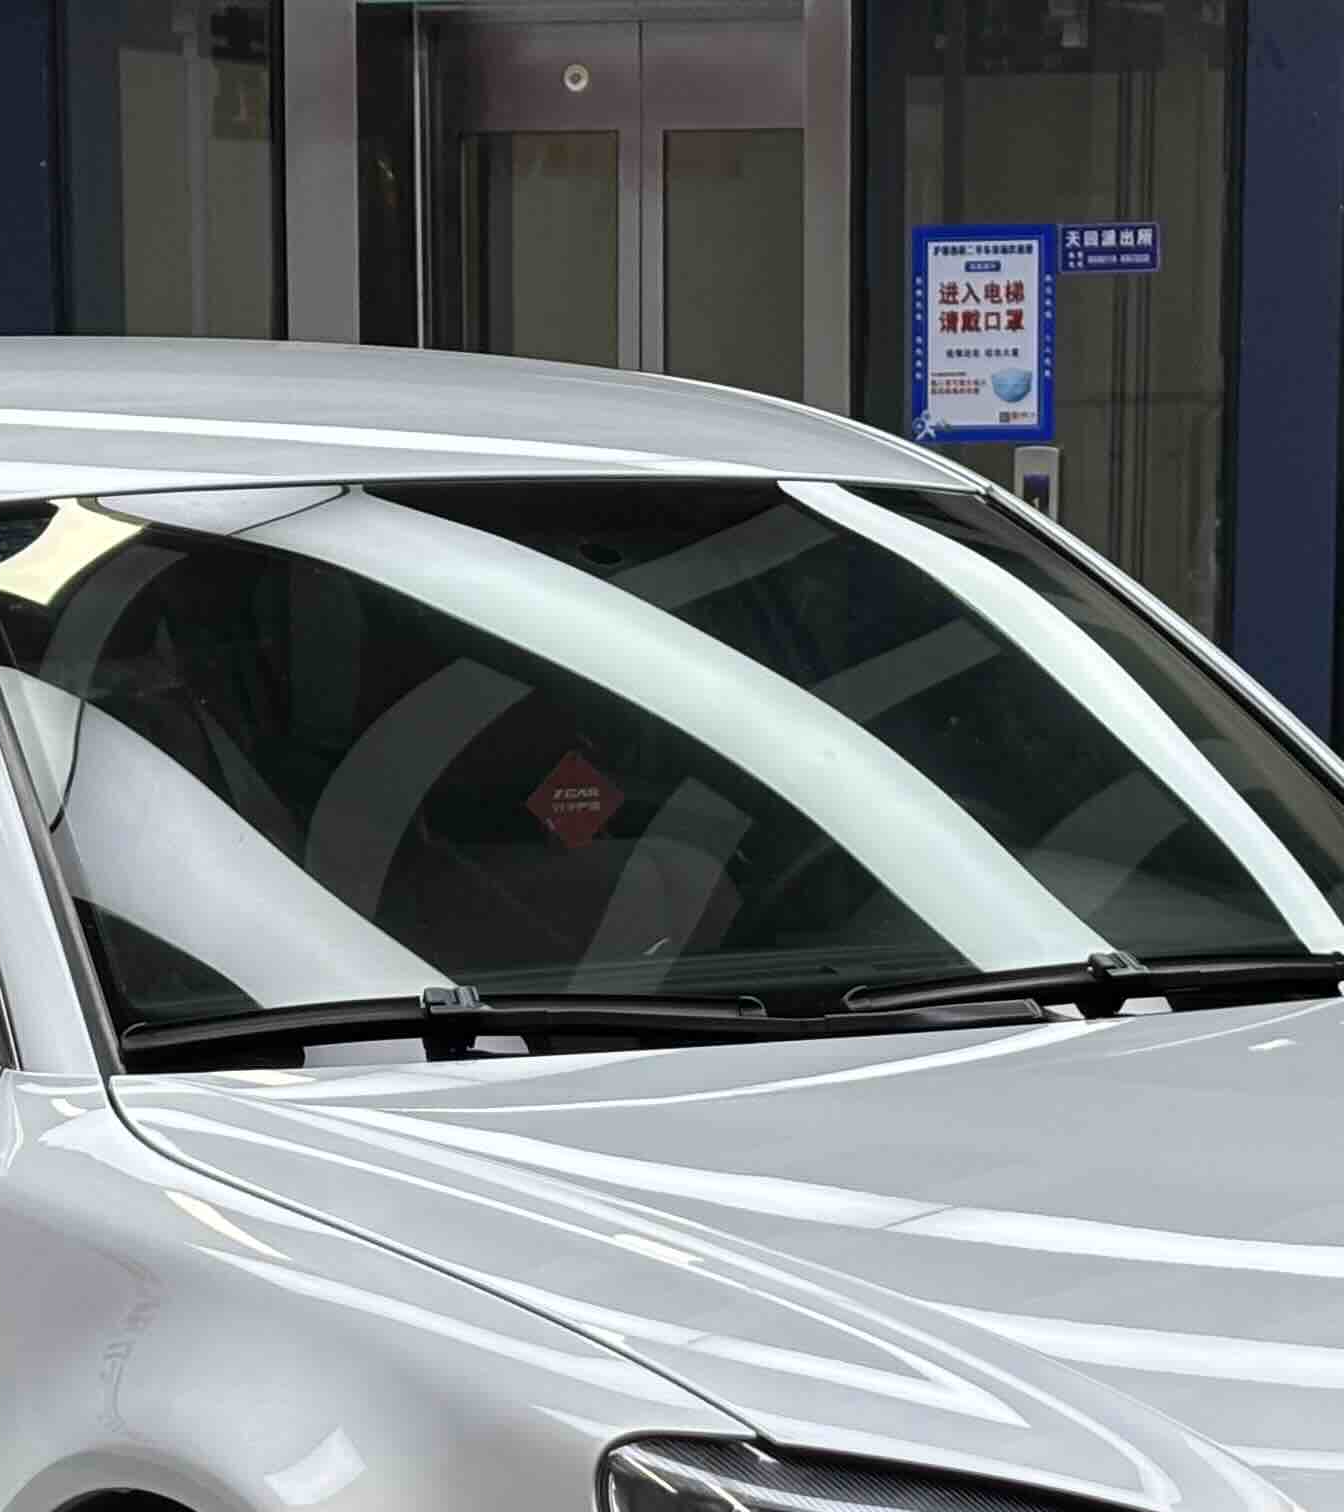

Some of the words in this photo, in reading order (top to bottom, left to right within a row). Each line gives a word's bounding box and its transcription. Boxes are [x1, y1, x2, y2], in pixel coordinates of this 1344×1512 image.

[938, 280, 1025, 304] 进入电梯
[938, 309, 1025, 333] 请戴口罩
